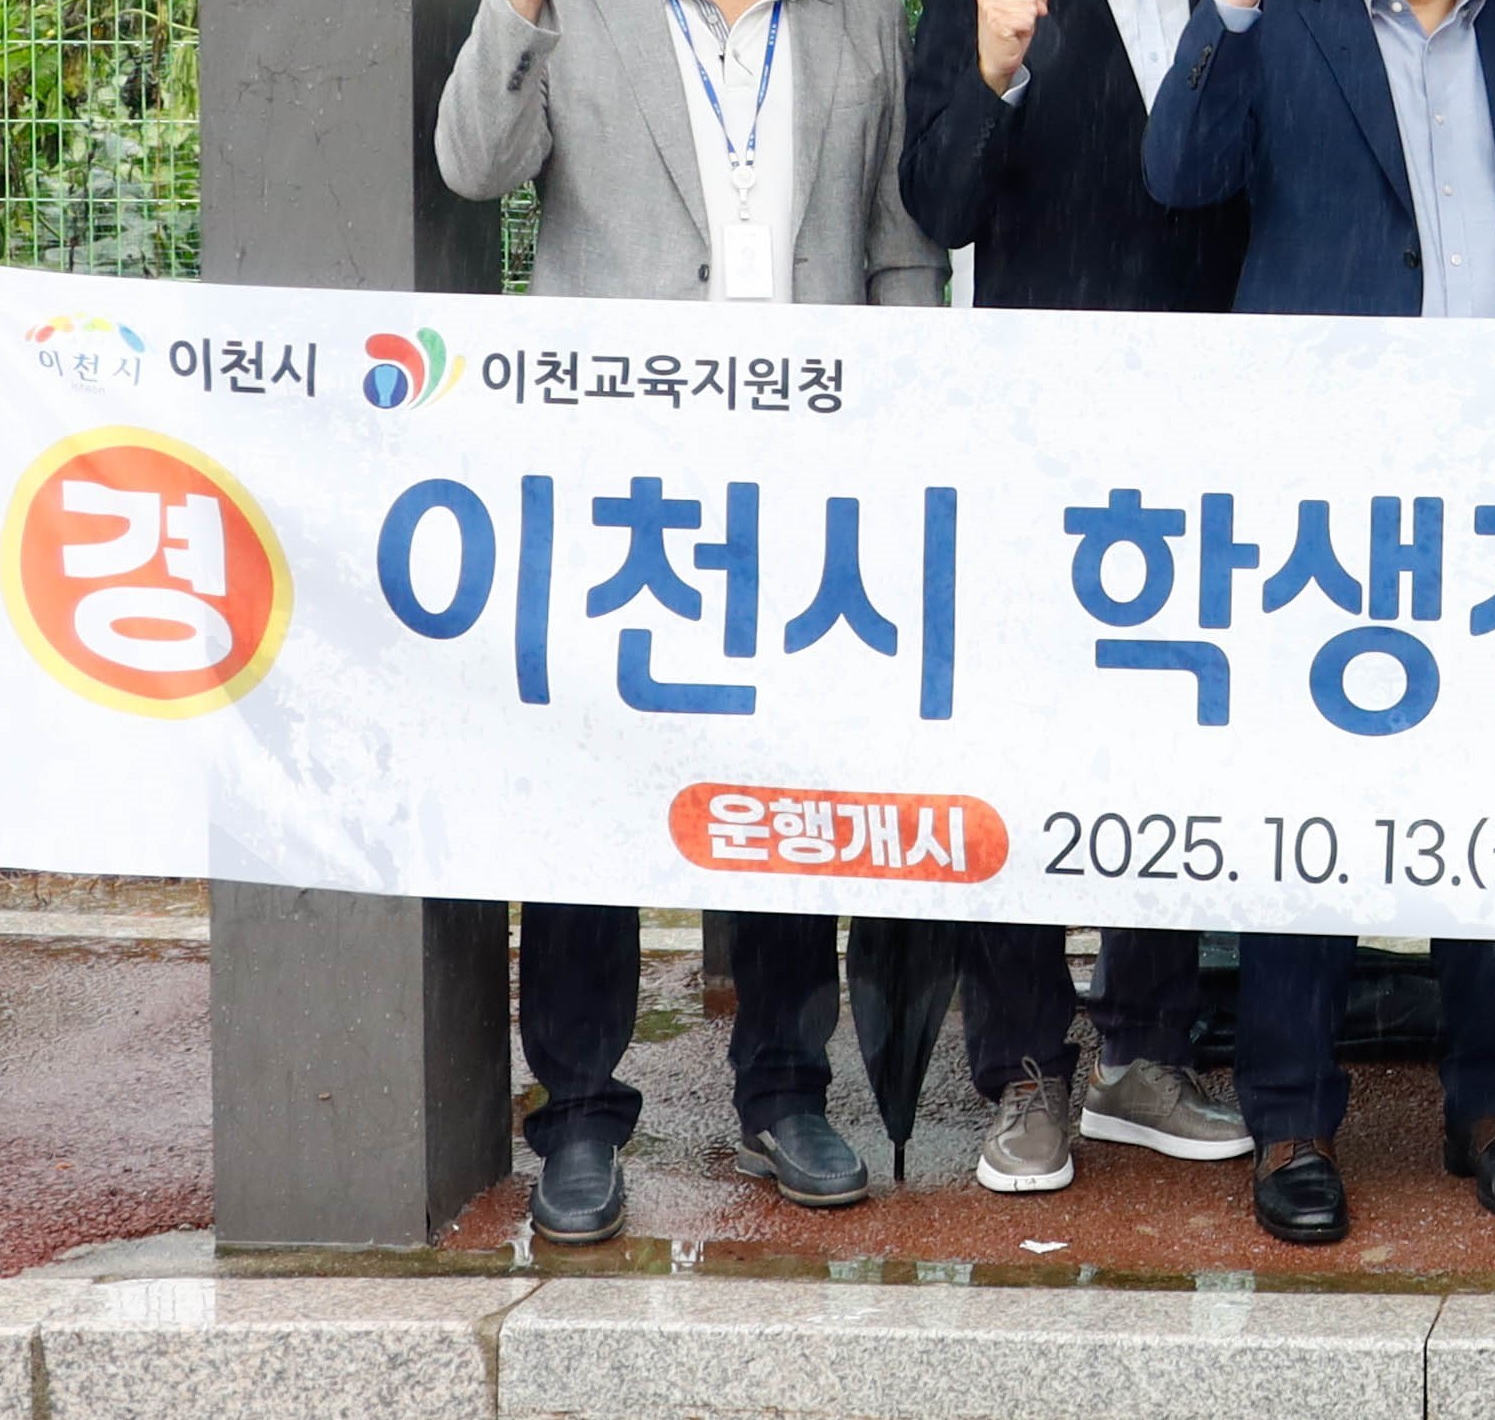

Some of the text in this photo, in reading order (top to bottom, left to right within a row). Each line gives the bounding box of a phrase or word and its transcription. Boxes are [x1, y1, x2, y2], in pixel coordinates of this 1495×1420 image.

[38, 337, 845, 415] 이천시 이천시 이천교육지원청
[61, 479, 234, 673] 경
[375, 474, 958, 721] 이천시
[705, 792, 967, 873] 운행개시
[1042, 812, 1240, 884] 2025.
[1263, 816, 1349, 885] 10.
